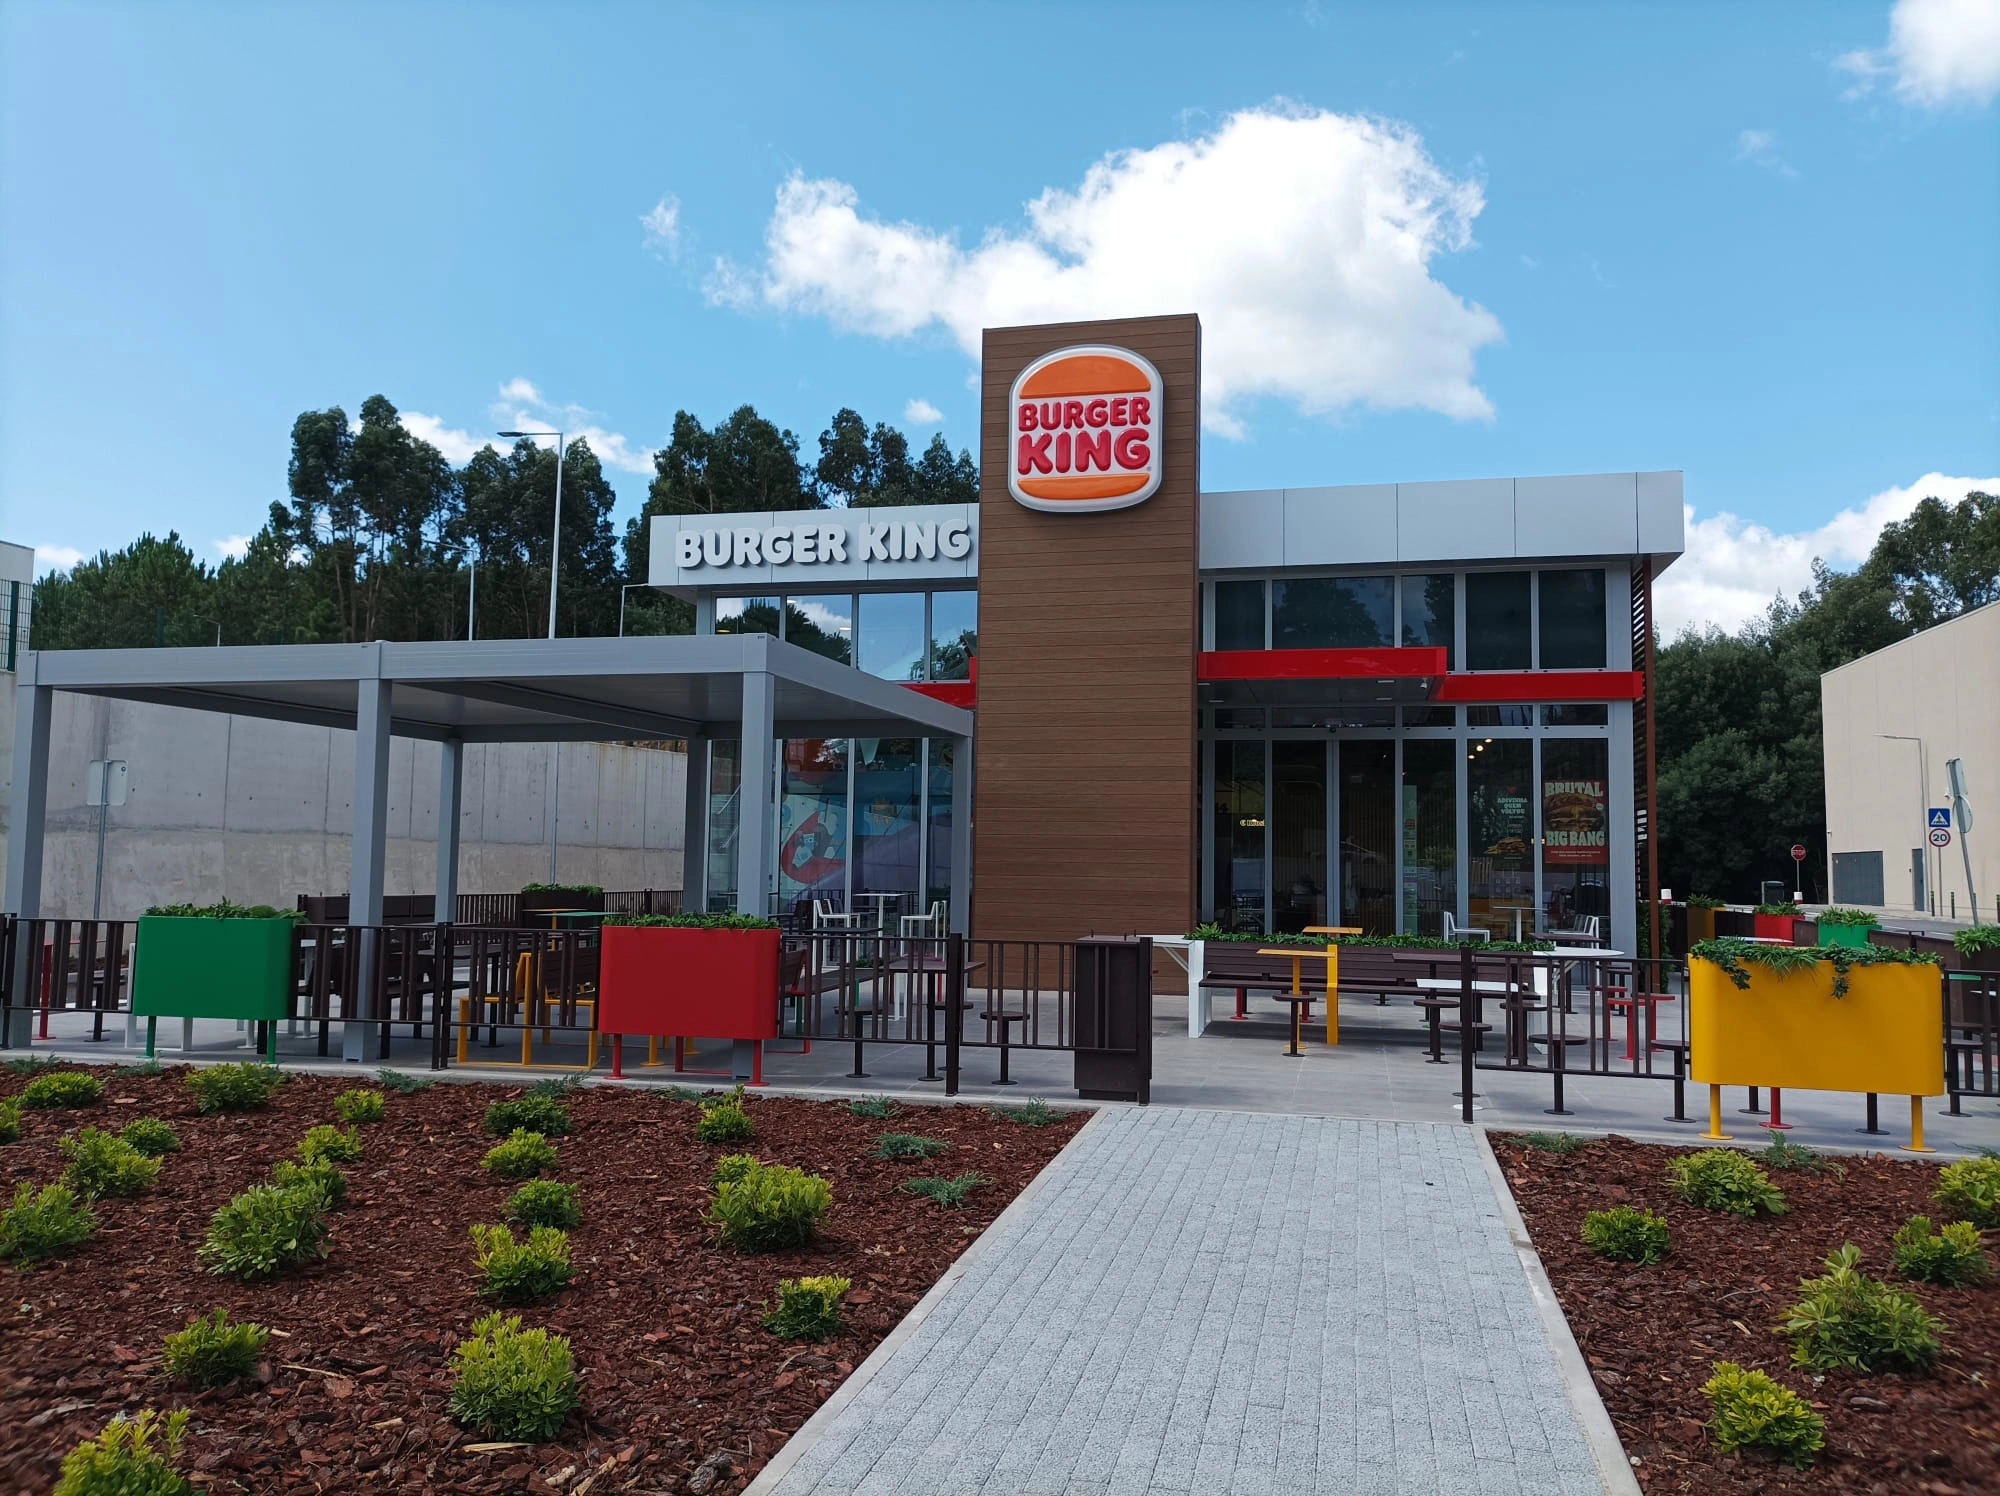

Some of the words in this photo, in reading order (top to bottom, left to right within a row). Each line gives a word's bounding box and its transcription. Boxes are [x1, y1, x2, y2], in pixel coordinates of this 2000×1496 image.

[1018, 397, 1151, 431] BURGER
[1017, 428, 1151, 475] KING
[675, 524, 847, 568] BURGER
[858, 519, 971, 561] KING
[1545, 782, 1604, 797] BRUTAL
[1546, 831, 1568, 847] BIG
[1569, 831, 1605, 847] BANG
